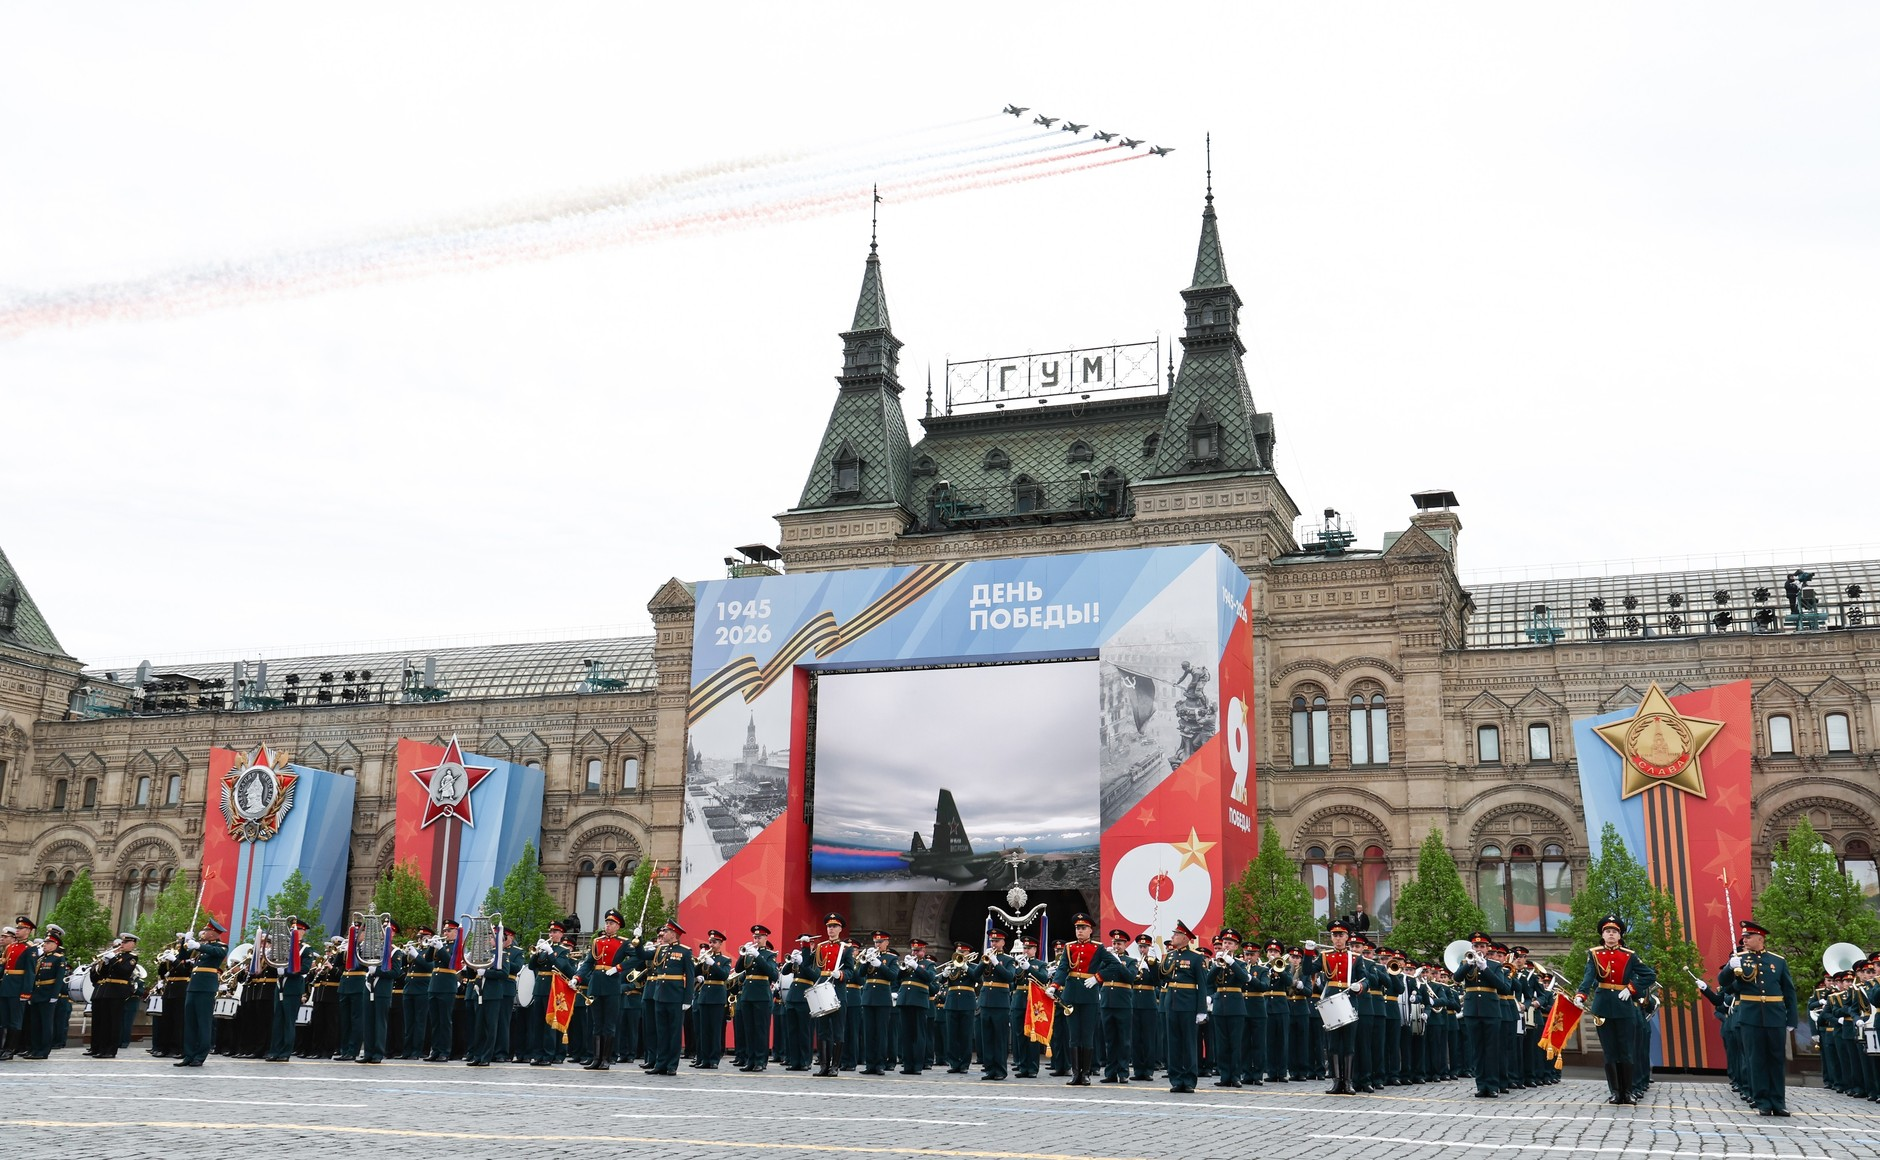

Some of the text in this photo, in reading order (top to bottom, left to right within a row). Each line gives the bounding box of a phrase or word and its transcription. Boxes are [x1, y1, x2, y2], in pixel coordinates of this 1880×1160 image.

[1000, 356, 1102, 392] ГУМ
[969, 581, 1043, 608] ДЕНЬ
[716, 599, 771, 622] 1945
[970, 602, 1100, 631] ПОБЕДЫ!
[715, 624, 772, 646] 2026
[1227, 696, 1249, 804] 9
[1638, 760, 1685, 775] СЛАВА
[1111, 842, 1212, 962] 9
